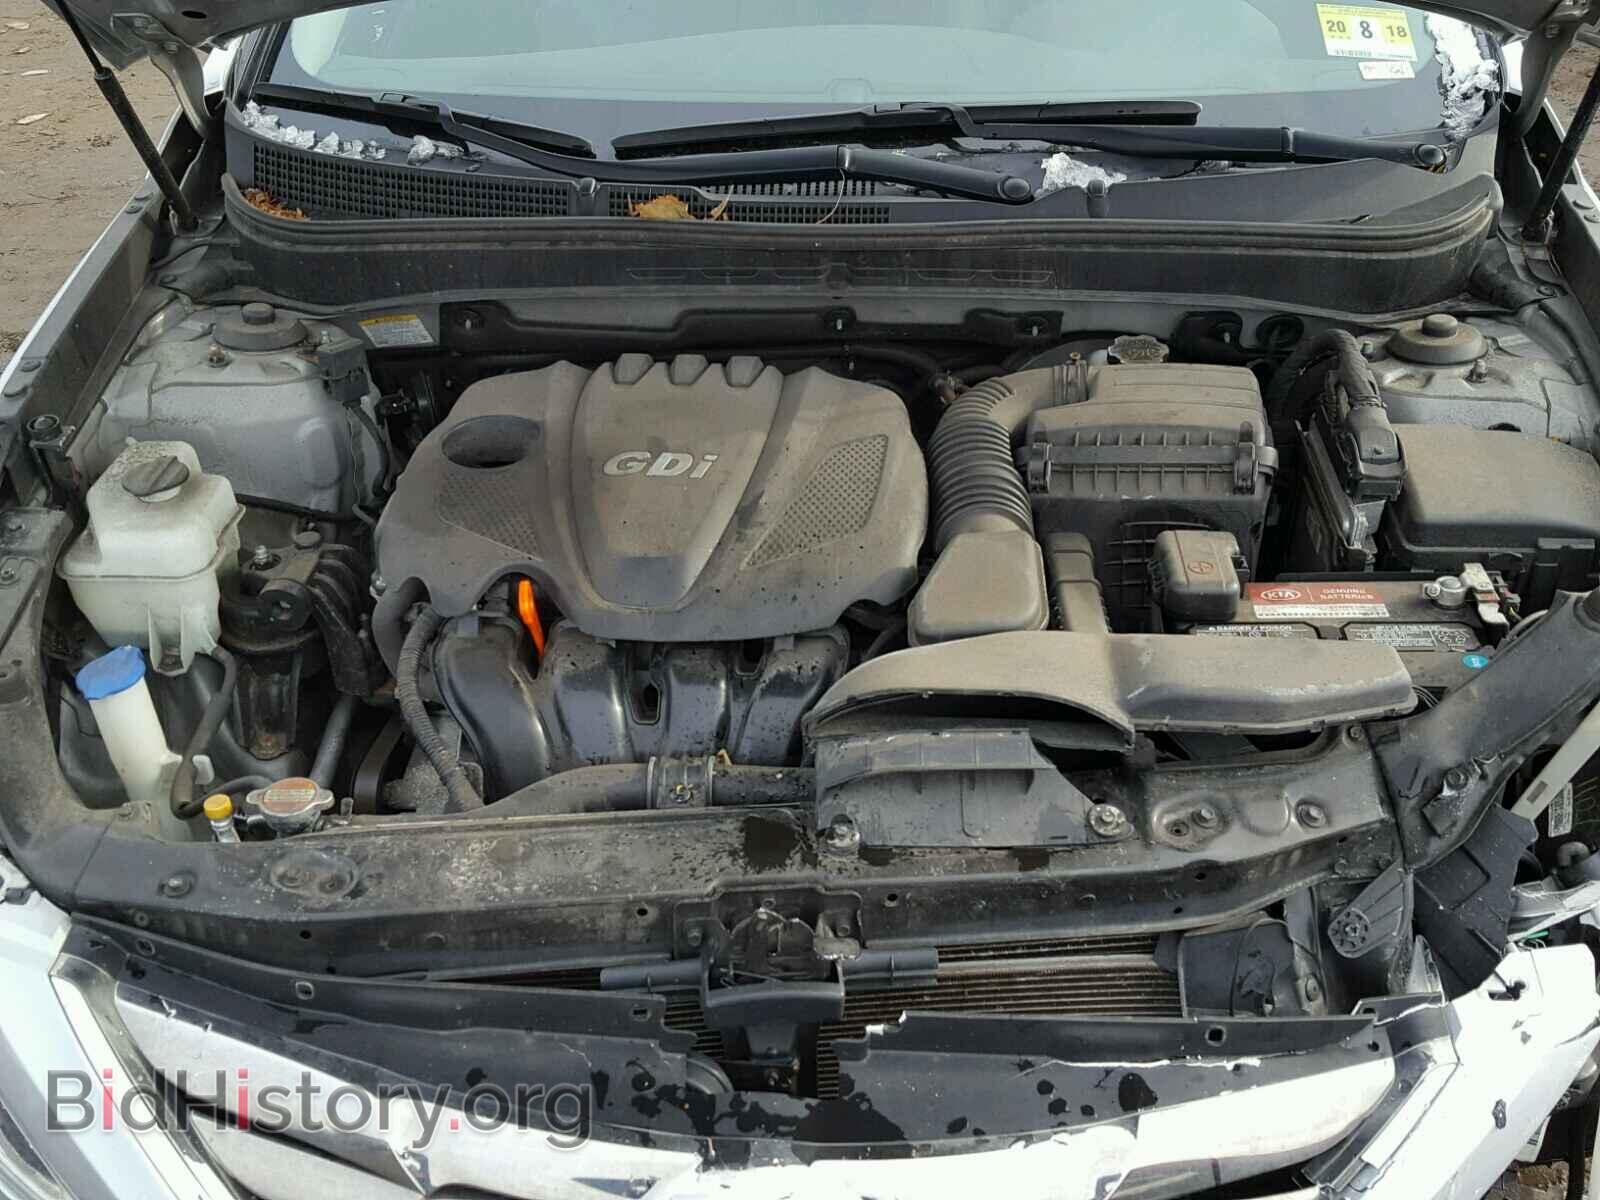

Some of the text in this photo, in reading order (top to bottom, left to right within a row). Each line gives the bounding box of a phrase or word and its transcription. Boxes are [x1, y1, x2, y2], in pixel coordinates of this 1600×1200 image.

[1326, 20, 1407, 39] 20 8 18
[603, 450, 719, 479] GDi
